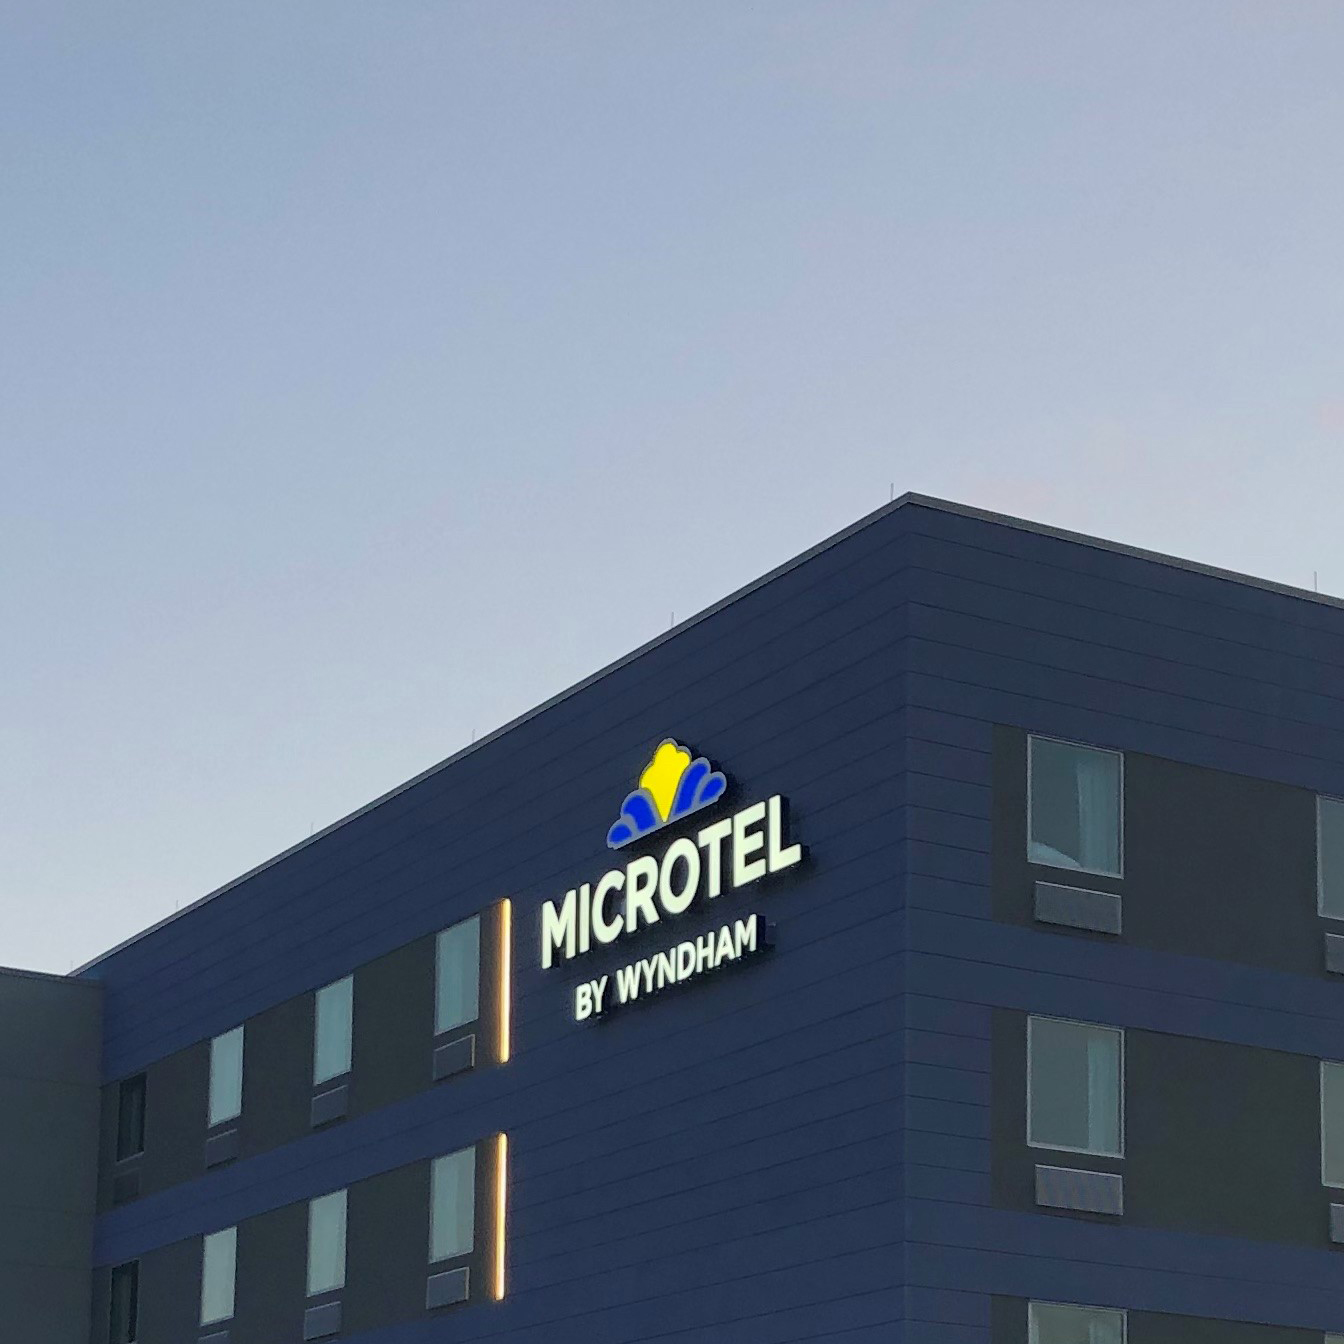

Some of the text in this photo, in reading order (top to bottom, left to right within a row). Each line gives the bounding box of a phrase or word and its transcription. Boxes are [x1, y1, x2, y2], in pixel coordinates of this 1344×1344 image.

[542, 794, 801, 969] MICROTEL
[575, 914, 757, 1021] BY WYNDHAM
